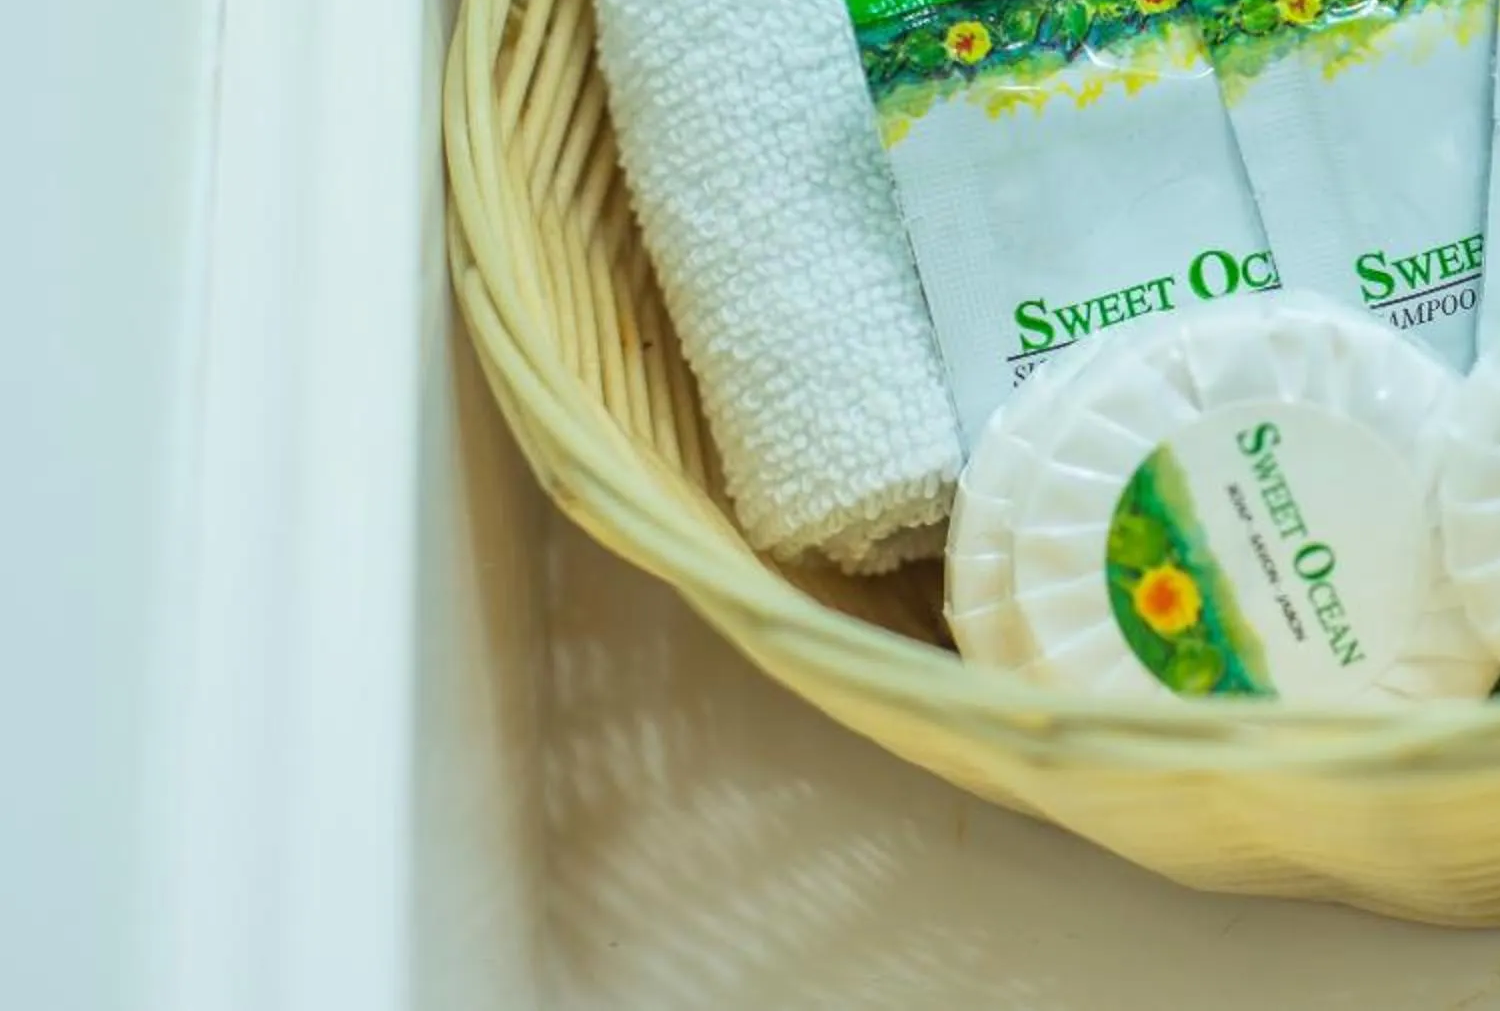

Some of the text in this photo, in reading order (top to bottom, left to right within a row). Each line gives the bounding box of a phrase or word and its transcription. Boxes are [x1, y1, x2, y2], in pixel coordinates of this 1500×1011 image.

[1356, 233, 1485, 302] SWEE
[1014, 276, 1176, 351] SWEET
[1389, 288, 1477, 330] AMPOO
[1236, 422, 1364, 668] SWEET OCEAN
